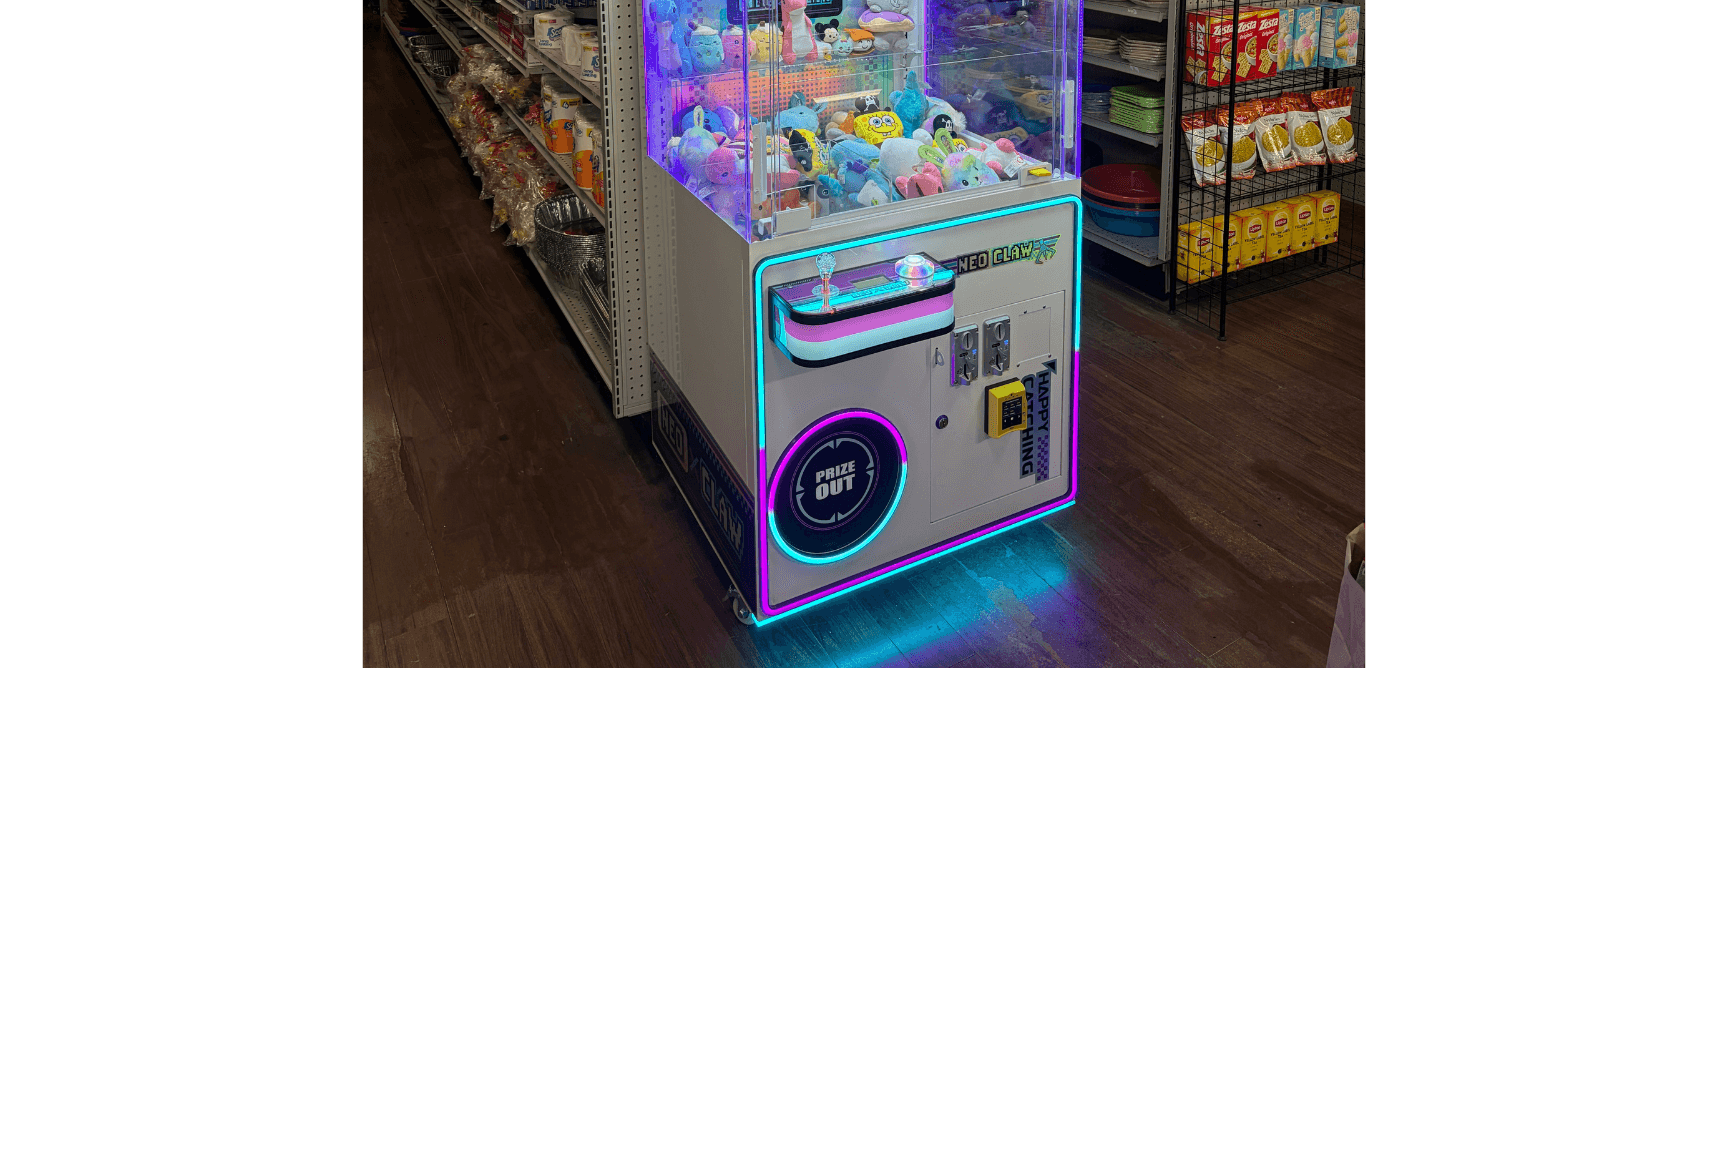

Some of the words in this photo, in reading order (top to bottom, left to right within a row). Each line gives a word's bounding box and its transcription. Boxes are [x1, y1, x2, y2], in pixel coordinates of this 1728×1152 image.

[550, 28, 562, 38] Sco
[1196, 21, 1205, 56] Zesta
[1238, 21, 1257, 34] Zesta
[1259, 18, 1278, 31] Zesta
[958, 252, 988, 273] NEO
[993, 241, 1034, 264] CLAW
[1038, 371, 1049, 432] HAPPY
[661, 403, 684, 456] NEO
[815, 460, 856, 484] PRIZE
[815, 473, 856, 500] OUT
[701, 466, 742, 549] CLAW
